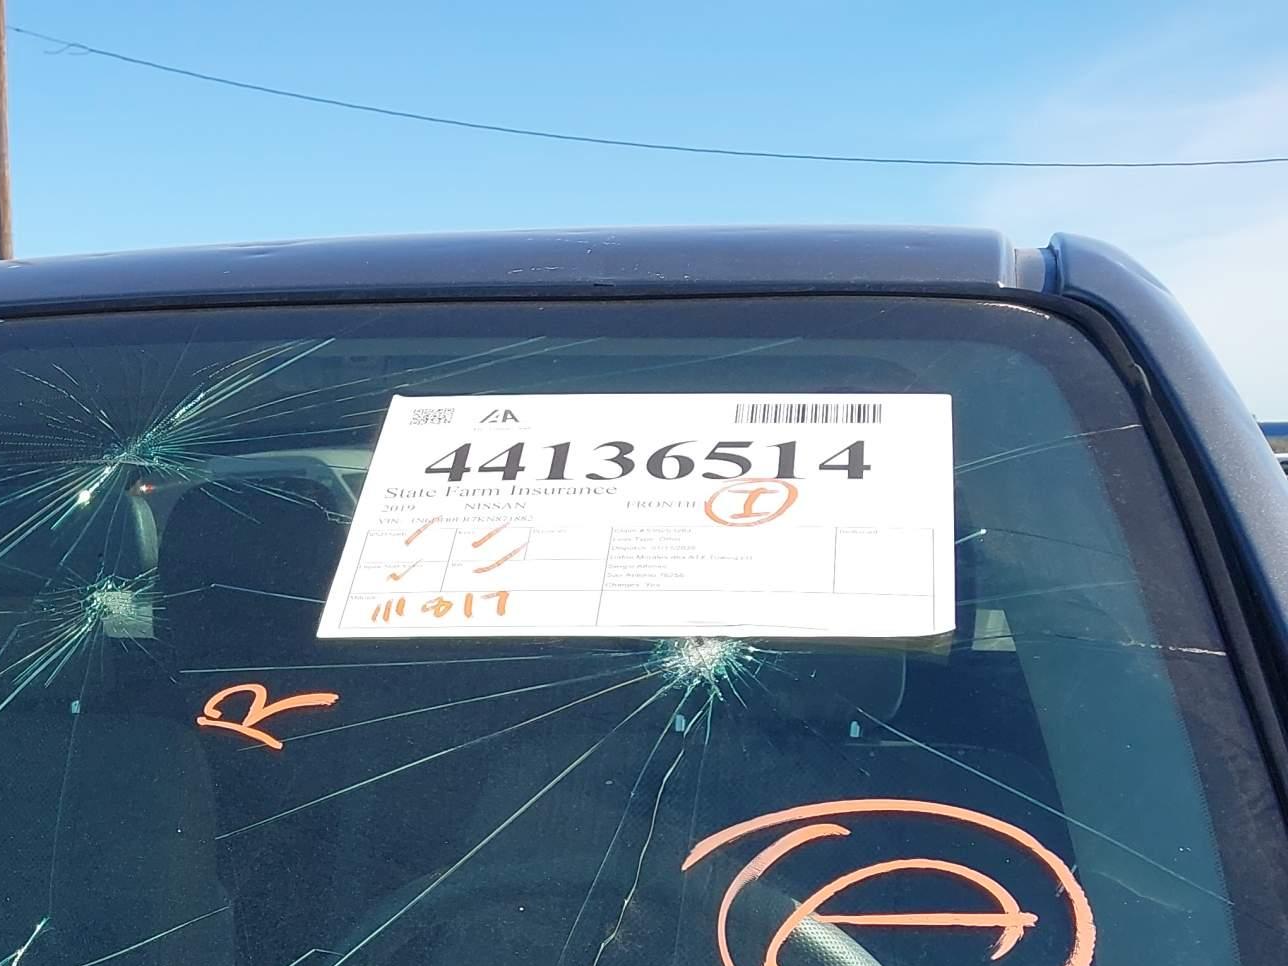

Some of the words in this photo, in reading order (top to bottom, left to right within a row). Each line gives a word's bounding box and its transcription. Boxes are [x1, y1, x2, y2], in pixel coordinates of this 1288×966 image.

[424, 440, 872, 481] 44136514
[383, 486, 438, 500] State
[445, 485, 501, 498] Farm
[510, 484, 619, 498] Insurance
[380, 504, 416, 513] 2019
[464, 501, 528, 511] NISSAN
